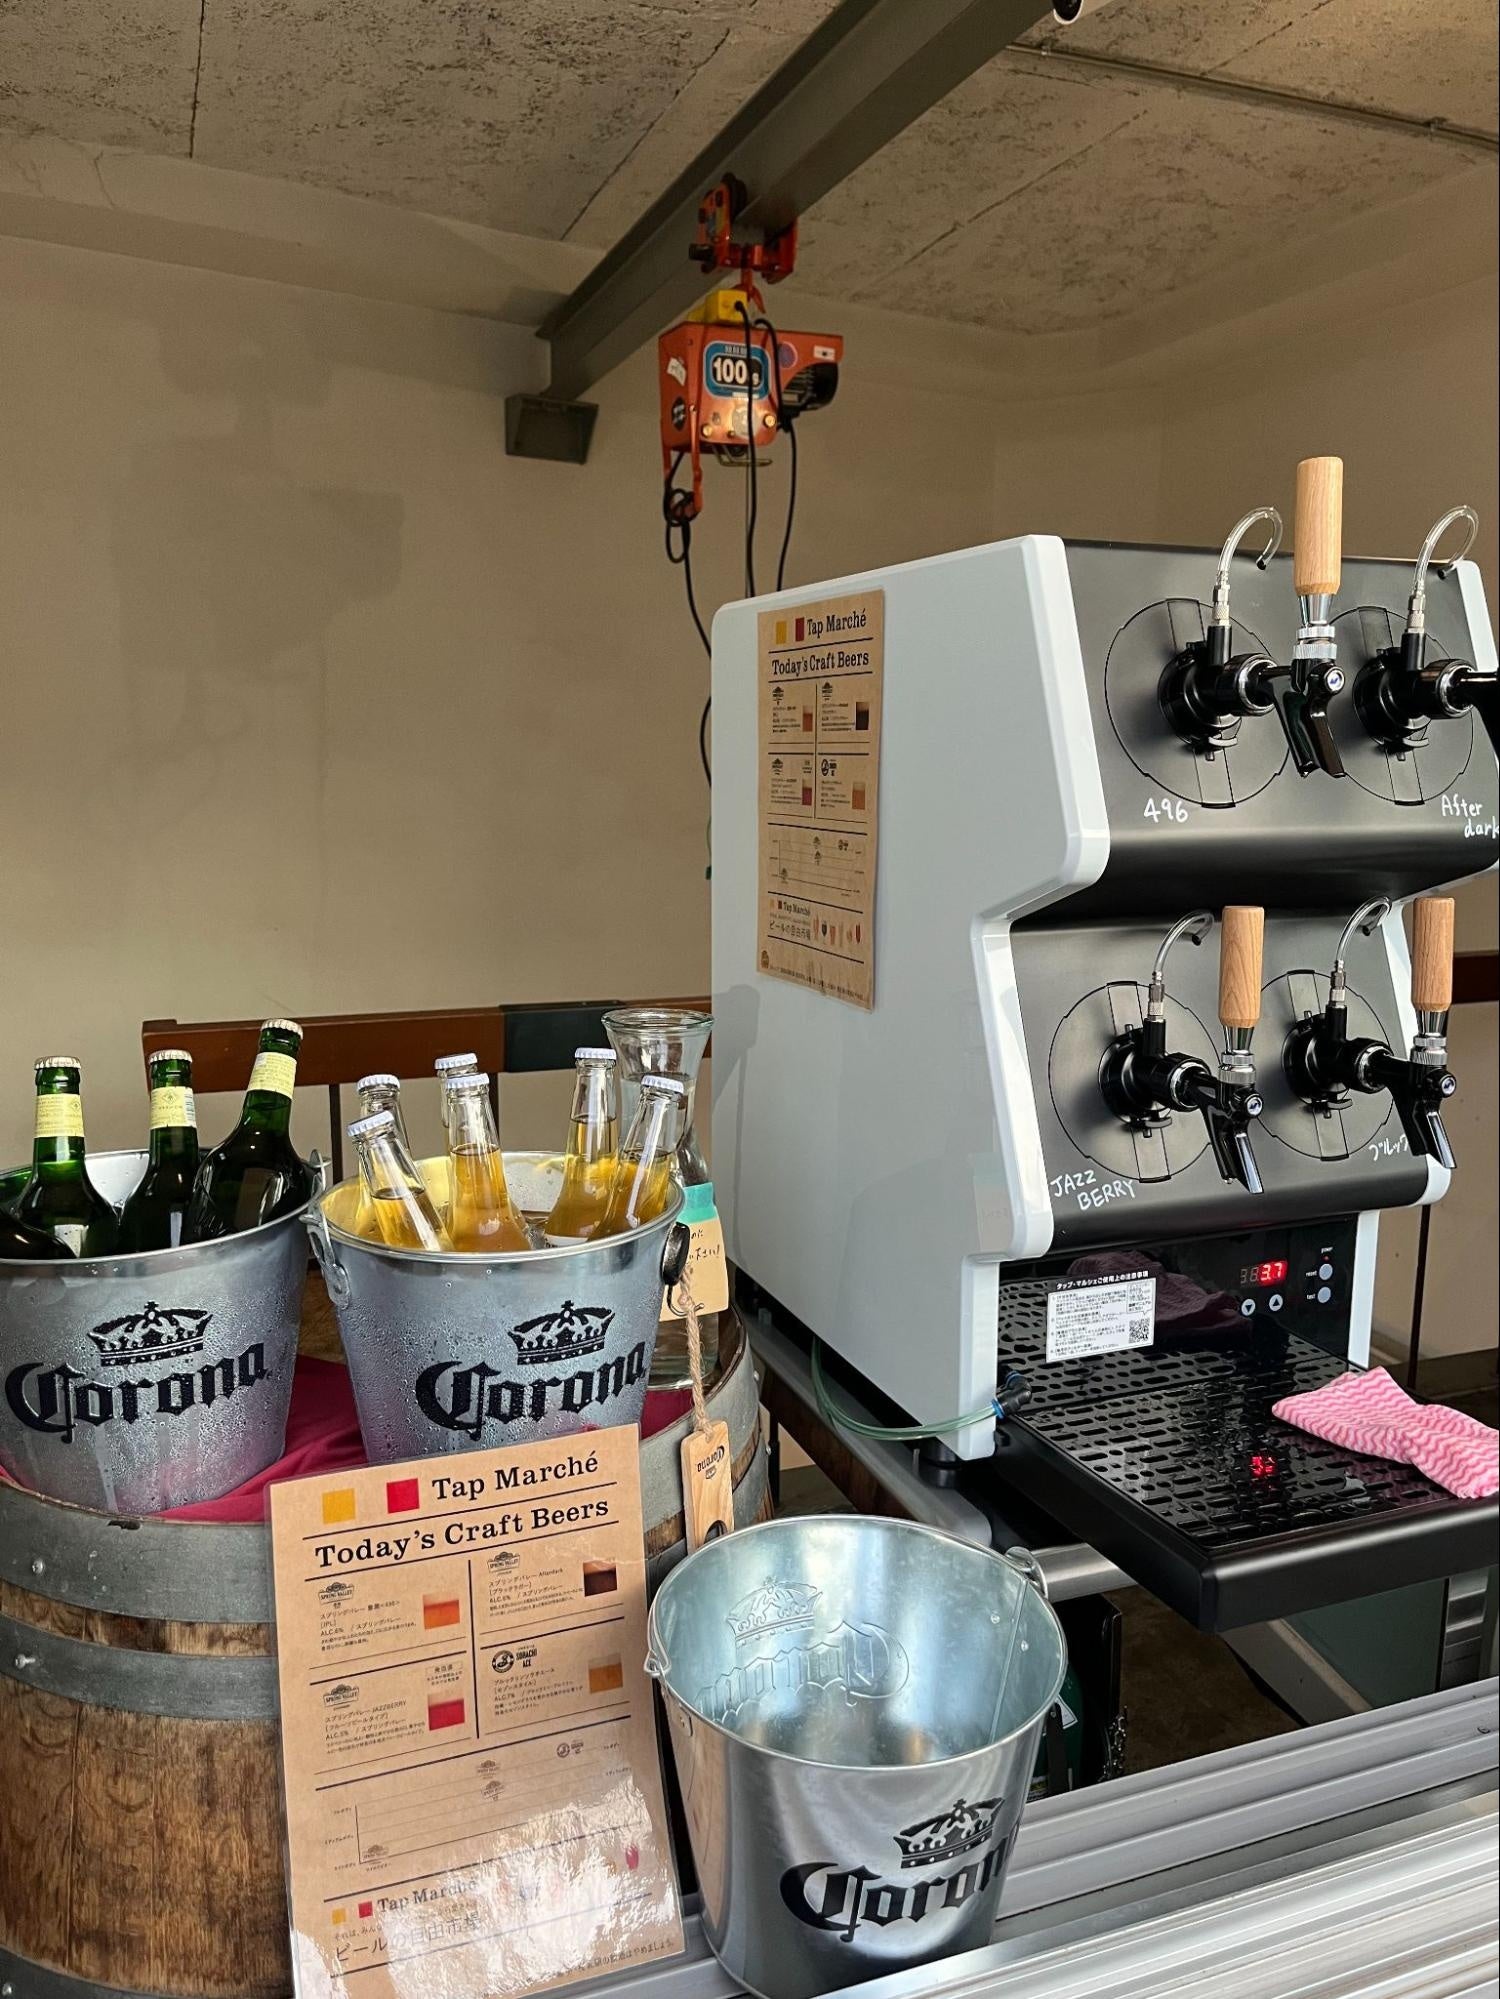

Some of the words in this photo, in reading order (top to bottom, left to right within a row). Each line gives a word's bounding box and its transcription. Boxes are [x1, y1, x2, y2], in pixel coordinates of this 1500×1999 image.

[713, 357, 759, 385] 100g
[807, 618, 823, 639] Tap
[826, 608, 867, 633] Marché
[772, 656, 808, 677] Today's
[809, 652, 835, 671] Craft
[837, 651, 869, 668] Beers
[1143, 797, 1188, 823] 496
[1441, 793, 1483, 817] After
[1464, 815, 1500, 839] dark
[1049, 1169, 1096, 1198] JAZZ
[1077, 1179, 1136, 1211] BERRY
[5, 1341, 270, 1444] Corona
[415, 1341, 648, 1442] Corona
[432, 1478, 486, 1502] Tap
[494, 1450, 599, 1490] Marché
[444, 1512, 523, 1546] Craft
[530, 1500, 609, 1530] Beers
[377, 1897, 410, 1913] Tap
